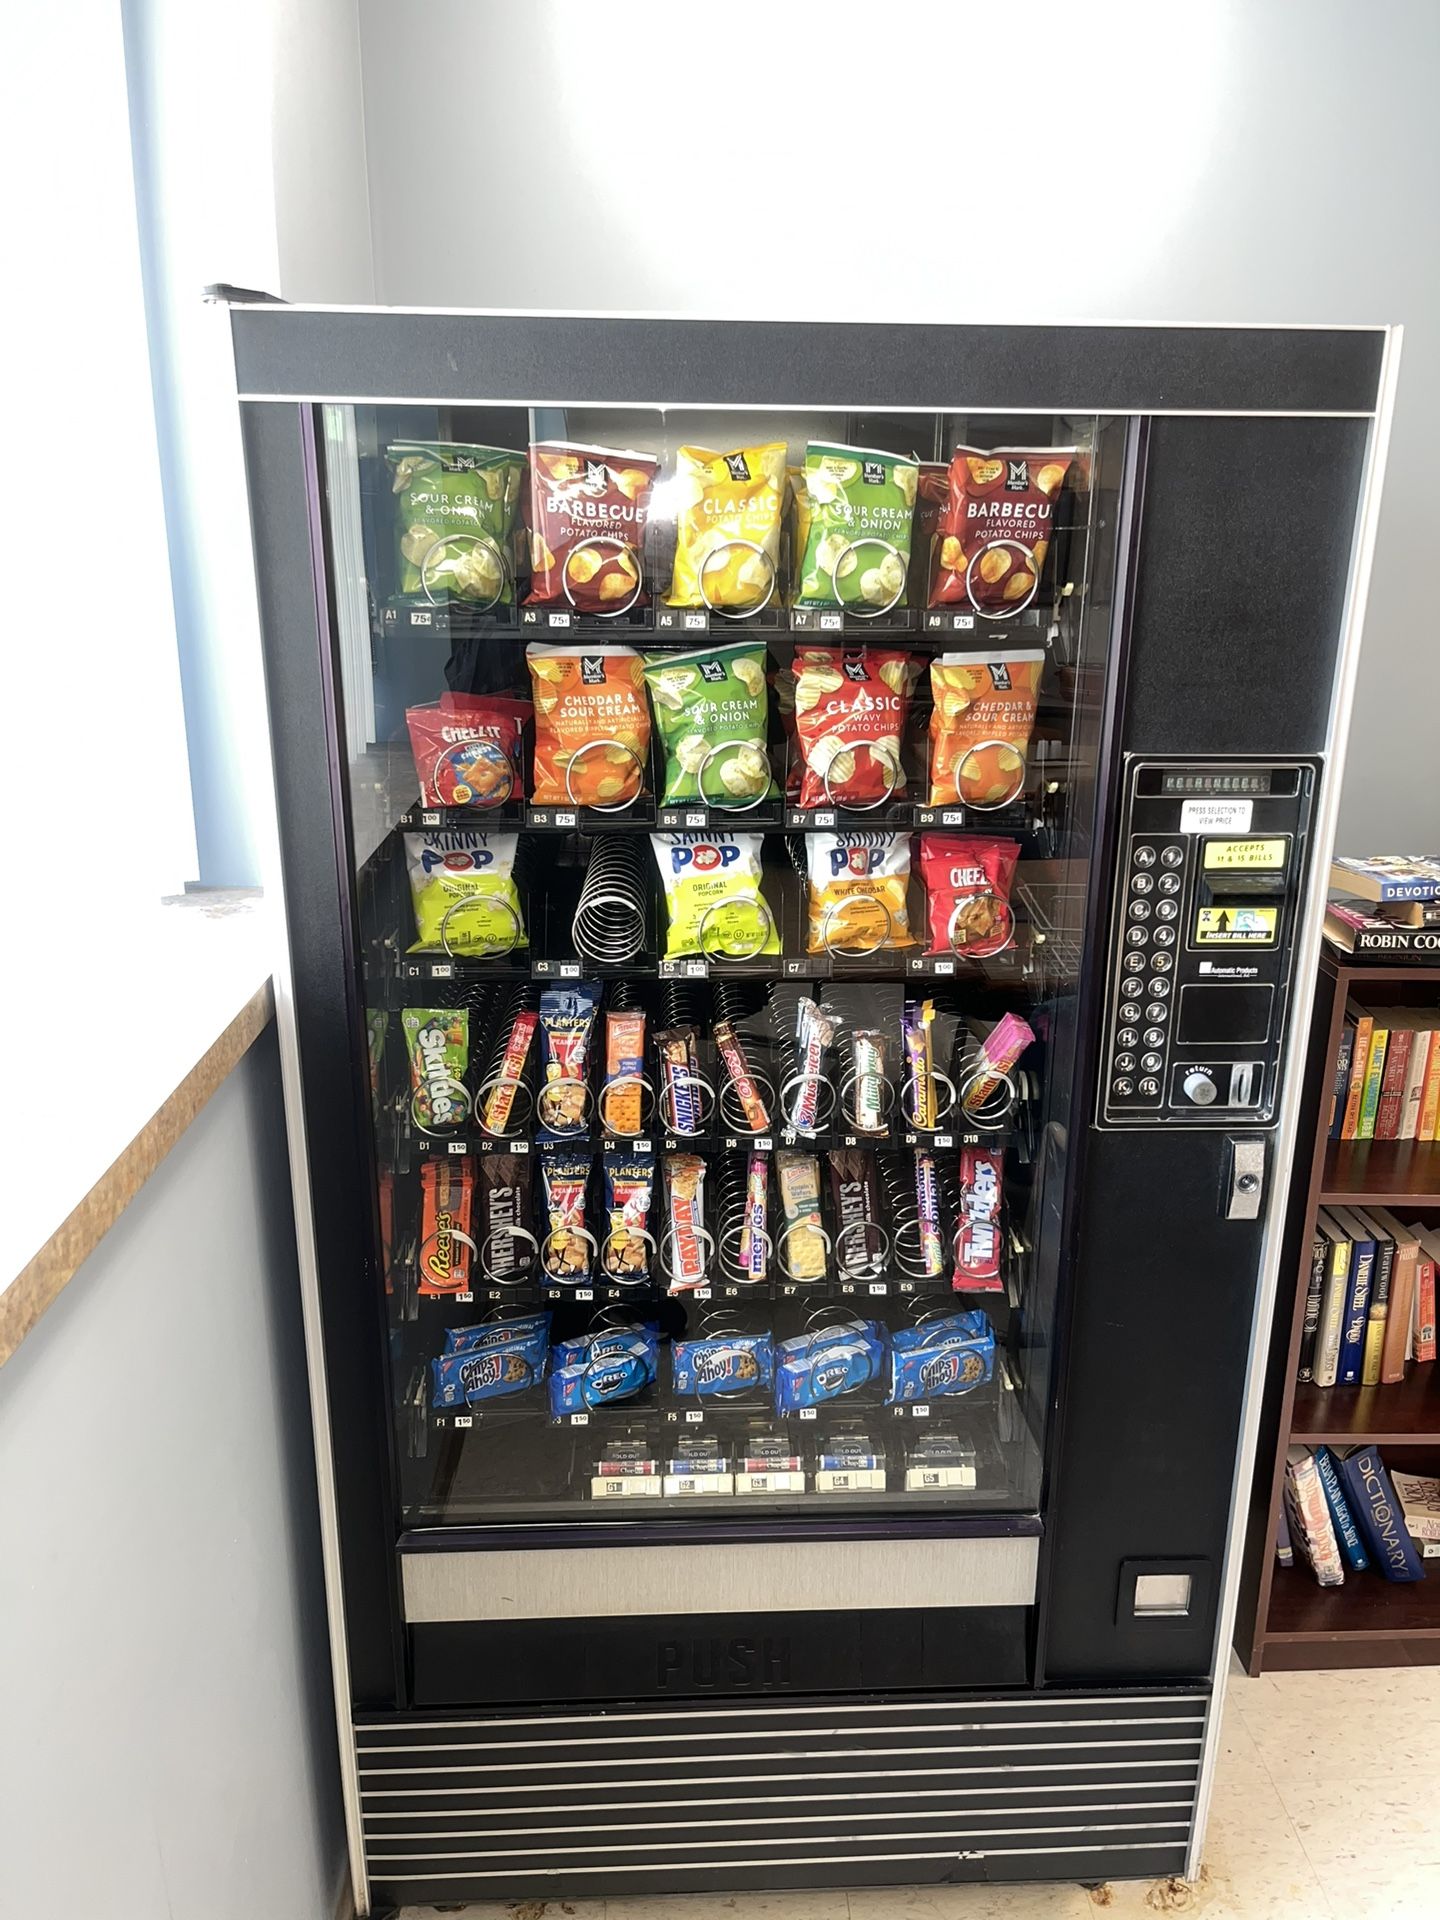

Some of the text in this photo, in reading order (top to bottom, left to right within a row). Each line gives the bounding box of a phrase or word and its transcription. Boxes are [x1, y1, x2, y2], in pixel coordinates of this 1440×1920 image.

[410, 492, 449, 505] SOUR
[546, 497, 644, 523] BARBECUE
[703, 495, 778, 515] CLASSIC
[835, 504, 868, 517] SOUR
[872, 507, 913, 519] CREAM
[571, 518, 622, 530] FLAVORED
[847, 518, 902, 530] & ONION
[986, 519, 1036, 529] FLAVORED
[560, 526, 629, 541] POTATO CHIPS
[974, 529, 1045, 540] POTATO CHIPS
[385, 610, 397, 620] A1
[524, 611, 537, 622] A3
[660, 616, 673, 627] A5
[795, 617, 807, 625] A7
[928, 617, 941, 626] A9
[564, 692, 635, 707] CHEDDAR &
[684, 699, 758, 717] SOUR CREAM
[826, 696, 901, 715] CLASSIC
[973, 700, 1033, 712] CHEDDAR &
[560, 704, 641, 718] SOUR CREAM
[694, 711, 750, 725] & ONION
[964, 712, 1035, 723] SOUR CREAM
[832, 722, 900, 733] POTATO CHIPS
[1188, 806, 1246, 815] PRESS SELECTION TO
[401, 815, 413, 824] B1
[534, 814, 548, 824] B3
[663, 815, 678, 825] B5
[792, 815, 806, 824] B7
[920, 814, 935, 823] B9
[1198, 816, 1233, 825] VIEW PRICE
[423, 832, 488, 852] SKINNY
[1226, 844, 1265, 853] ACCEPTS
[421, 849, 494, 874] POP
[671, 845, 741, 874] POP
[830, 847, 886, 877] POP
[1139, 852, 1149, 863] A
[1248, 853, 1273, 861] BILLS
[1137, 878, 1146, 888] B
[1165, 878, 1172, 888] 2
[1134, 905, 1143, 915] C
[1132, 931, 1141, 941] D
[1159, 931, 1168, 941] 4
[1205, 931, 1267, 939] INSERT BILL HERE
[1360, 934, 1410, 948] ROBIN
[537, 962, 548, 971] C3
[911, 960, 923, 969] C9
[1130, 957, 1138, 966] E
[1157, 957, 1165, 966] 5
[409, 967, 420, 976] C1
[663, 963, 675, 972] C5
[788, 964, 800, 973] C7
[1210, 966, 1259, 974] Automatic Products
[1128, 982, 1136, 992] F
[1154, 982, 1162, 992] 6
[1125, 1007, 1134, 1017] G
[1152, 1007, 1160, 1017] 7
[1123, 1032, 1132, 1042] H
[1150, 1032, 1158, 1042] 8
[1121, 1057, 1129, 1067] J
[1147, 1057, 1155, 1067] 9
[1185, 1065, 1213, 1077] return
[1118, 1082, 1128, 1091] K
[1143, 1082, 1156, 1091] 10
[666, 1140, 677, 1148] D5
[726, 1139, 737, 1147] D6
[786, 1137, 796, 1145] D7
[845, 1137, 856, 1145] D8
[906, 1135, 917, 1143] D9
[964, 1135, 979, 1143] D10
[419, 1142, 430, 1150] D1
[482, 1142, 493, 1150] D2
[543, 1141, 554, 1149] D3
[604, 1141, 615, 1149] D4
[609, 1167, 653, 1179] PLANTERS
[489, 1186, 515, 1273] HERSHEY'S
[428, 1211, 452, 1279] Reese's
[1355, 1253, 1374, 1292] DANIELLE
[1378, 1246, 1394, 1300] Heartwood
[726, 1288, 738, 1296] E6
[784, 1286, 797, 1294] E7
[901, 1283, 913, 1291] E9
[489, 1291, 501, 1299] E2
[549, 1290, 561, 1298] E3
[591, 1371, 628, 1389] OREO
[816, 1366, 849, 1385] OREO
[894, 1407, 904, 1415] F9
[436, 1418, 446, 1426] F1
[667, 1413, 677, 1421] F5
[752, 1478, 763, 1487] G3
[834, 1476, 845, 1485] G4
[924, 1474, 935, 1482] G5
[1318, 1453, 1334, 1488] BELVA
[1328, 1477, 1342, 1504] PLAIN
[607, 1482, 618, 1491] G1
[680, 1480, 691, 1489] G2
[1358, 1456, 1410, 1572] DICTIONARY
[657, 1638, 791, 1689] PUSH
